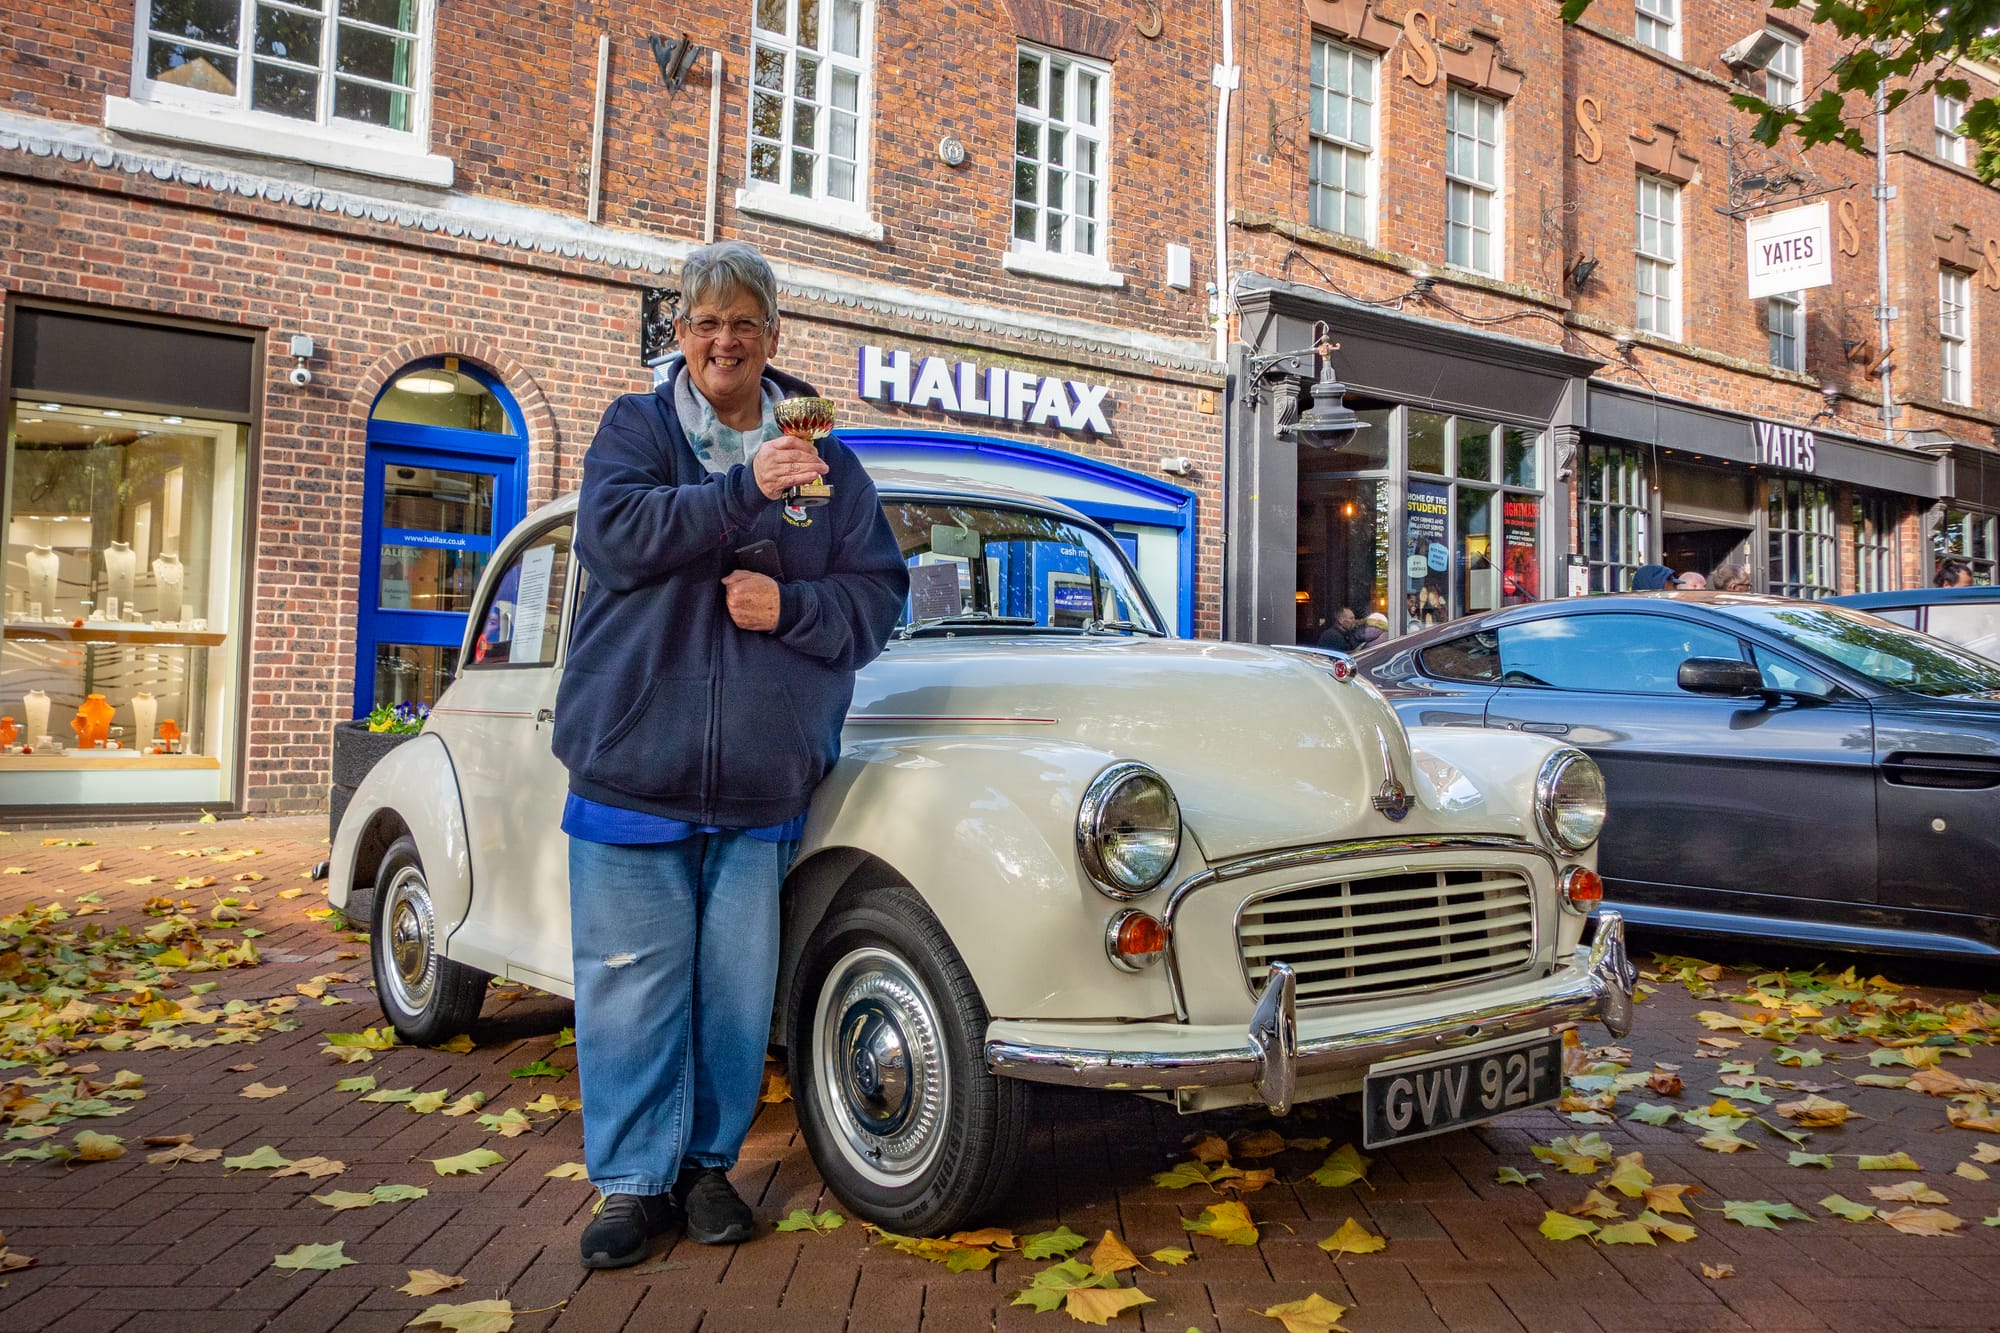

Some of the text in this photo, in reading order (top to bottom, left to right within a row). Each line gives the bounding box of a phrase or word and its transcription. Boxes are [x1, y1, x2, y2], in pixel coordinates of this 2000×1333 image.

[1763, 236, 1813, 266] YATES
[859, 345, 1112, 435] HALIFAX
[1759, 421, 1815, 473] YATES
[1408, 493, 1447, 505] HOME OF THE
[1408, 502, 1448, 514] STUDENTS
[404, 536, 466, 546] www.halifax.co.uk
[1061, 548, 1077, 556] cash
[1386, 1047, 1549, 1131] GVV 92F
